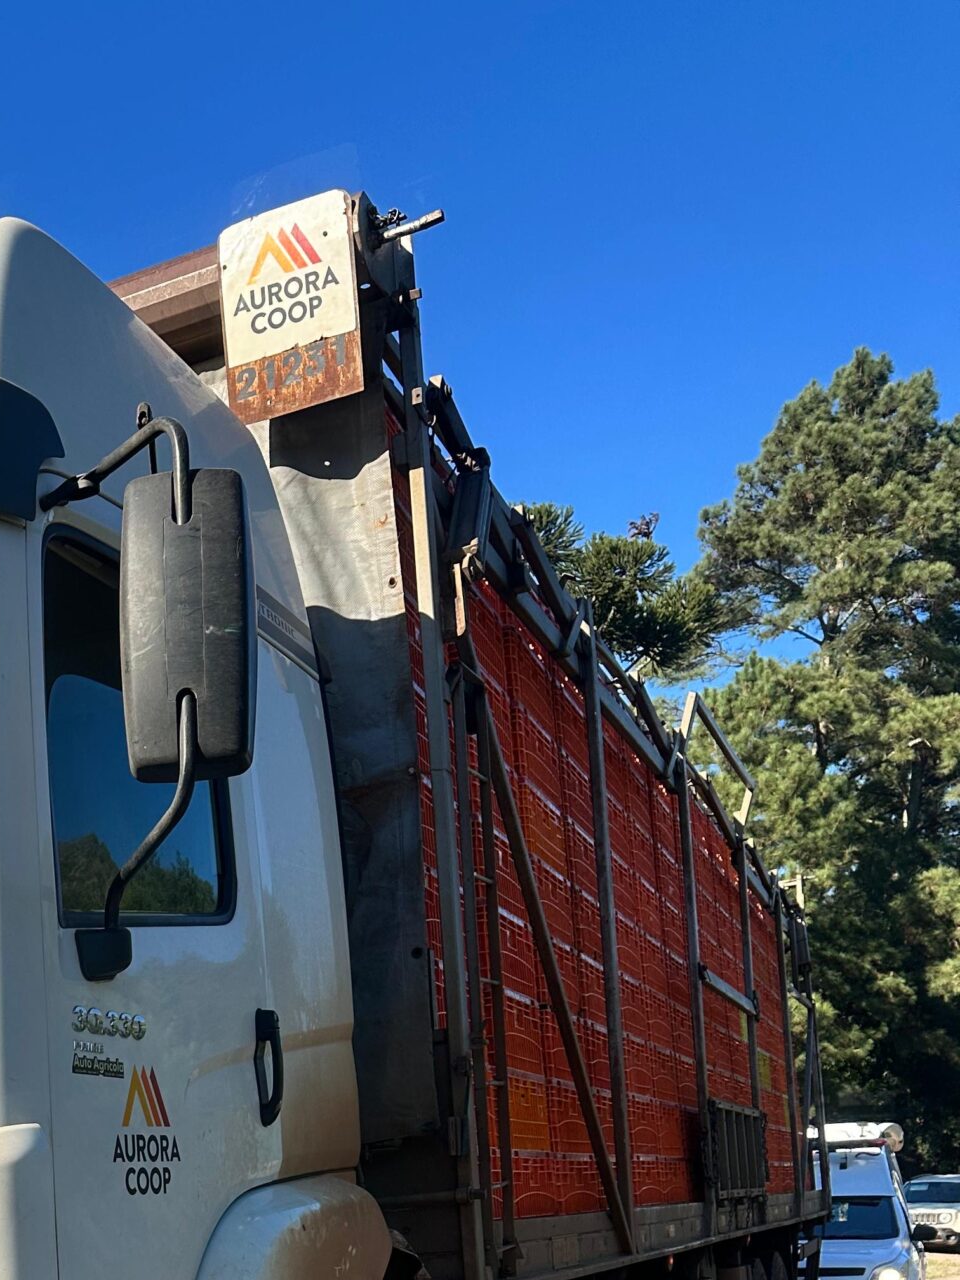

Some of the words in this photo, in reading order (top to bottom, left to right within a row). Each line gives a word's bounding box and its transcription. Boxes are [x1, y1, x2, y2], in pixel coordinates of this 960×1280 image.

[233, 266, 340, 317] AURORA
[250, 295, 323, 335] COOP
[71, 1005, 147, 1040] 30.330
[74, 1055, 92, 1069] Auto
[113, 1134, 181, 1163] AURORA
[125, 1167, 171, 1195] COOP
